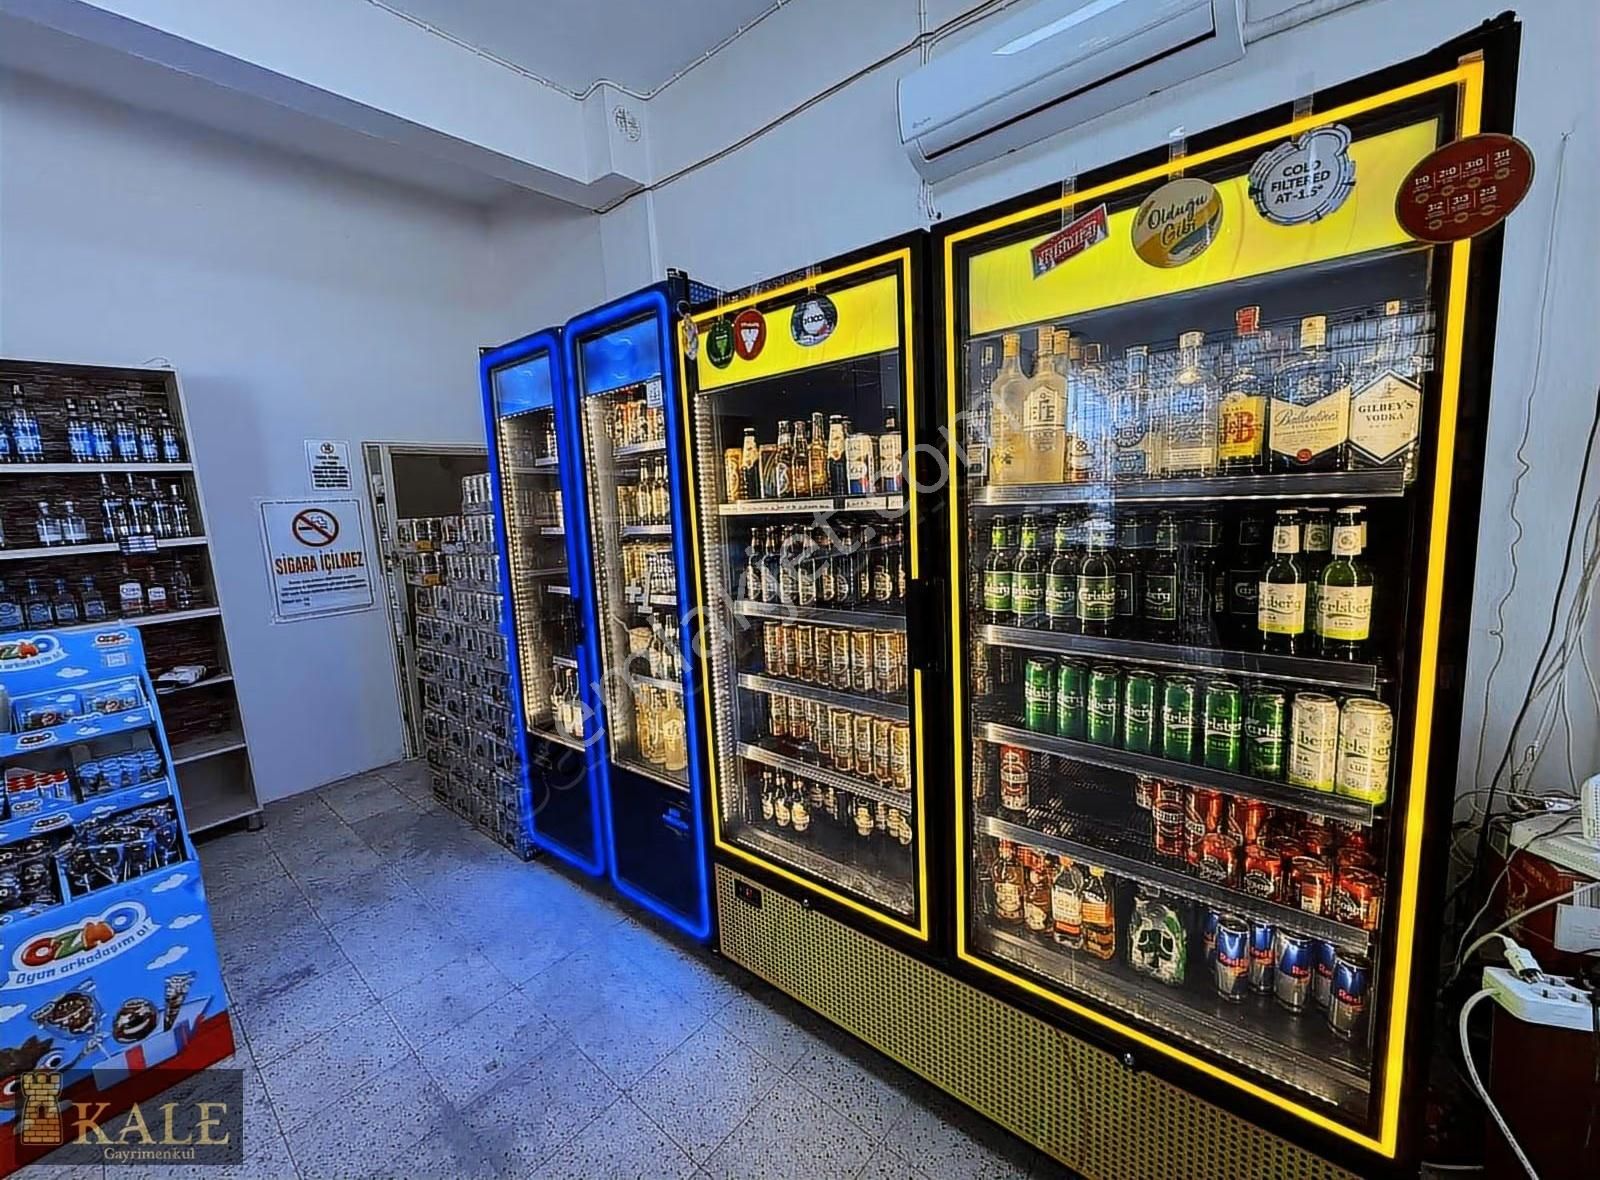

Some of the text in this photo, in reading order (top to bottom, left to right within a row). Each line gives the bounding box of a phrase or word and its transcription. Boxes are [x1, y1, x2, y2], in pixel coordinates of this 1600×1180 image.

[1282, 160, 1321, 177] COLD
[1271, 170, 1331, 192] FILTERED
[1162, 218, 1196, 246] Gibi
[1358, 400, 1415, 414] GILBEY'S
[1366, 413, 1404, 423] VODKA
[275, 549, 365, 576] SİGARA İÇİLMEZ
[16, 968, 56, 985] Oyun
[60, 934, 135, 974] arkadaşım
